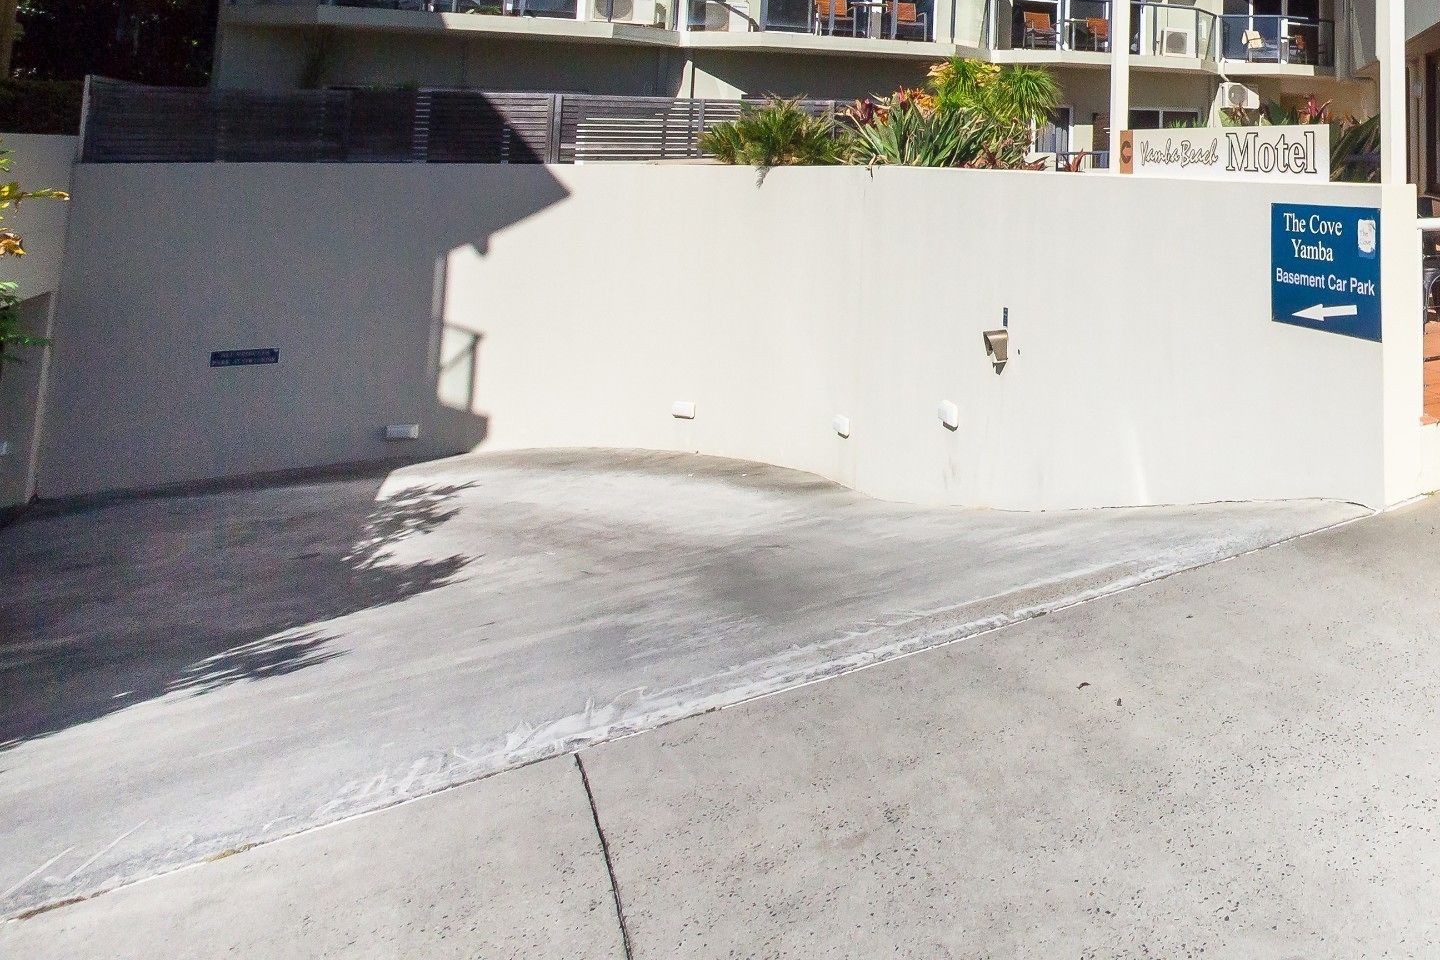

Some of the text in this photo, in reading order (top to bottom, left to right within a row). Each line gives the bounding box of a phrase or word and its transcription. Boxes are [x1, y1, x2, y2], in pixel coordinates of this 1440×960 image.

[1140, 130, 1318, 174] Yamba Beach Motel
[1283, 212, 1343, 236] The Cove
[1291, 238, 1334, 262] Yamba
[1276, 267, 1376, 297] Basement Car Park
